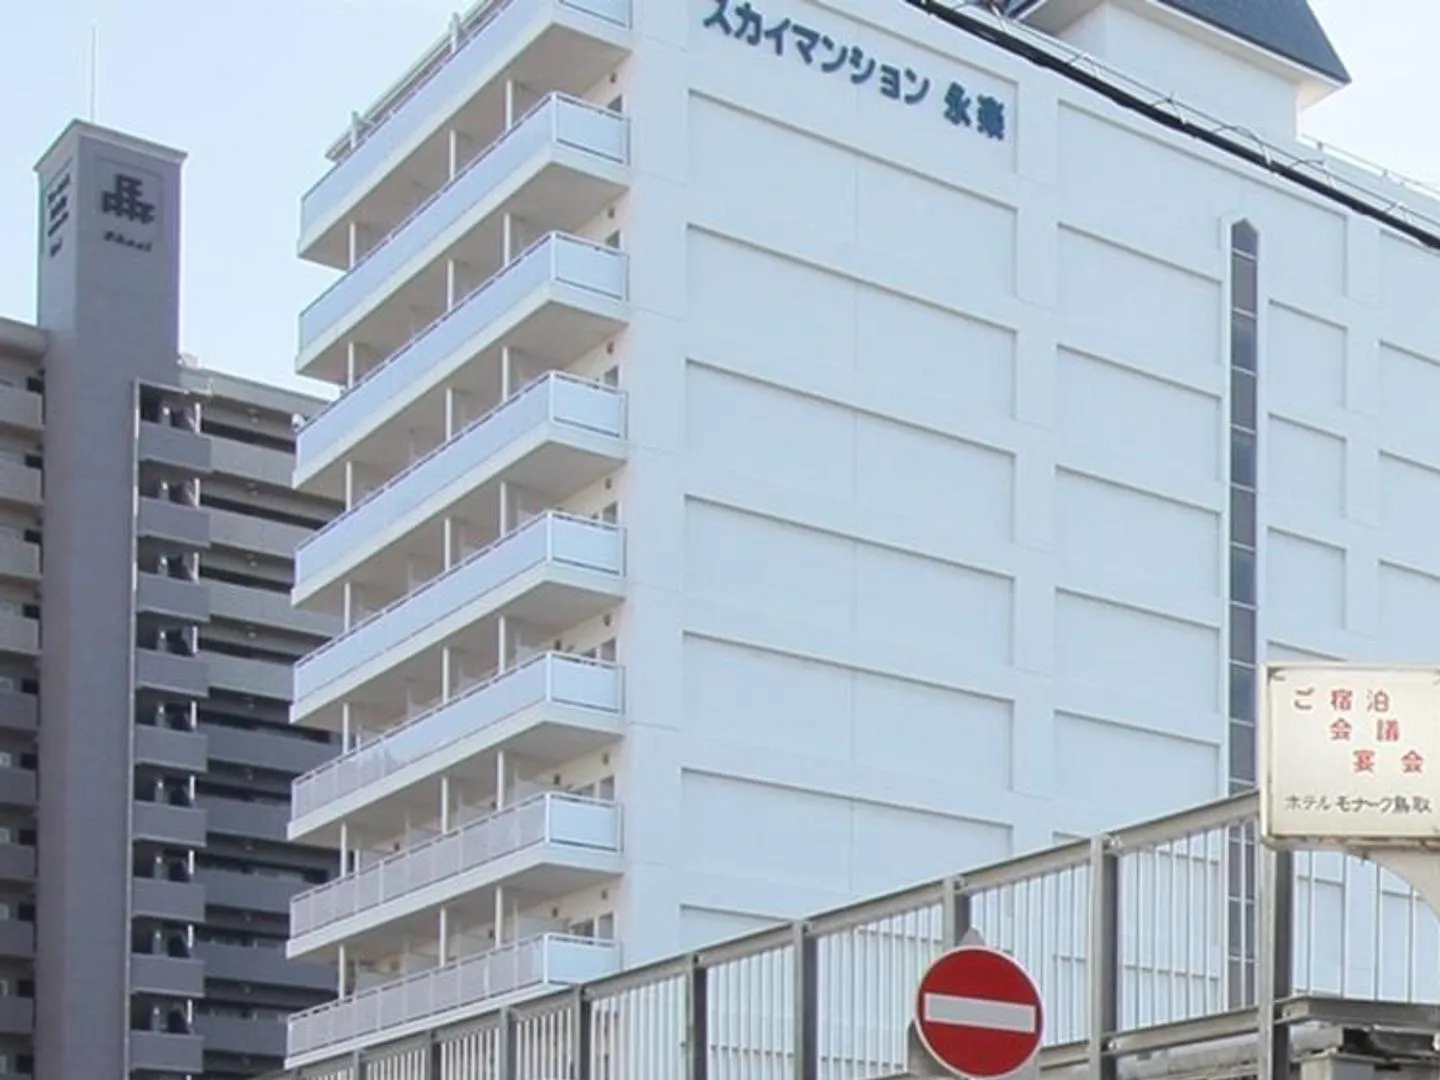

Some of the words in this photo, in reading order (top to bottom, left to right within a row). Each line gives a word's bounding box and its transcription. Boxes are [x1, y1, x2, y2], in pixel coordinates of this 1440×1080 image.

[703, 0, 930, 105] スカイマンション
[1293, 687, 1390, 712] ご宿泊
[1352, 749, 1424, 774] 宴会
